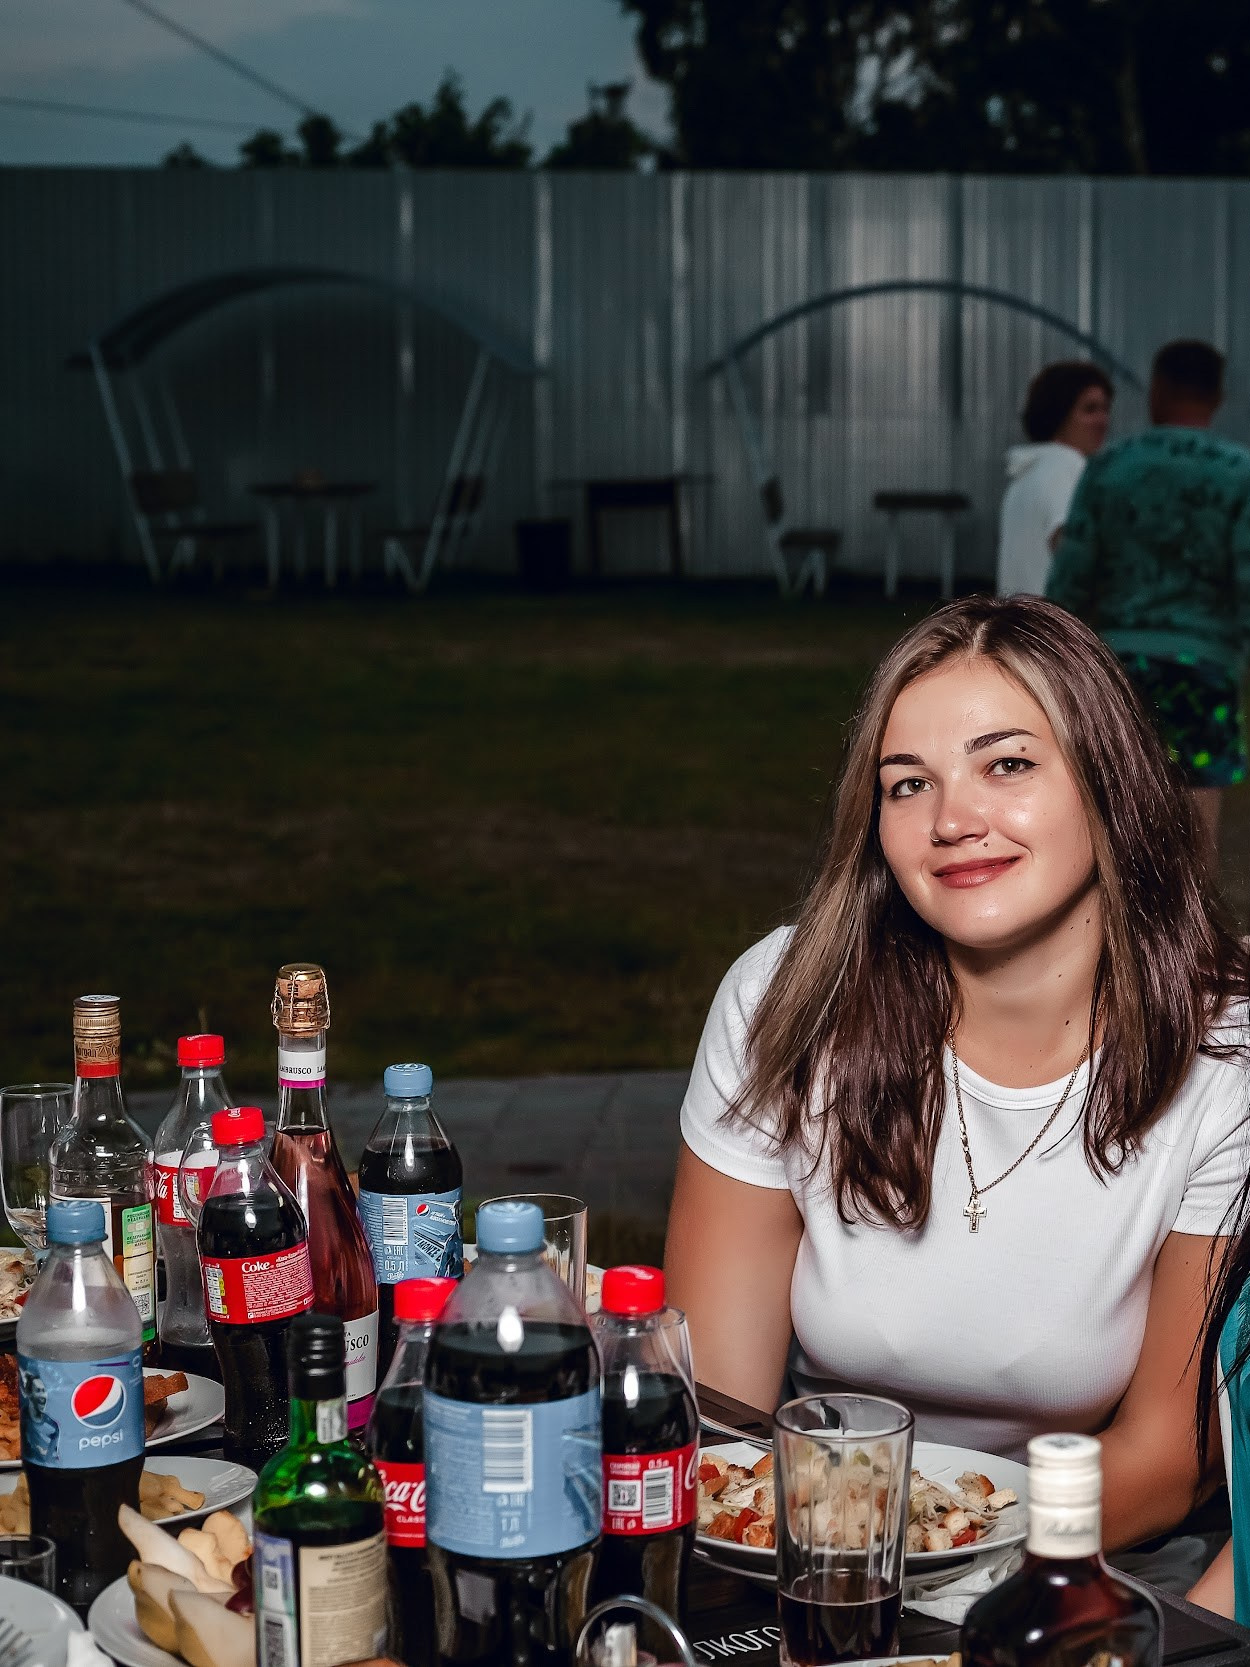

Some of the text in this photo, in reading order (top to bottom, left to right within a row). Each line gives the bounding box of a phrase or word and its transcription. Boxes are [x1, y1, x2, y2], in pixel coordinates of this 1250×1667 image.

[242, 1261, 270, 1273] Coke
[384, 1259, 396, 1271] 0.5
[79, 1429, 123, 1451] pepsi
